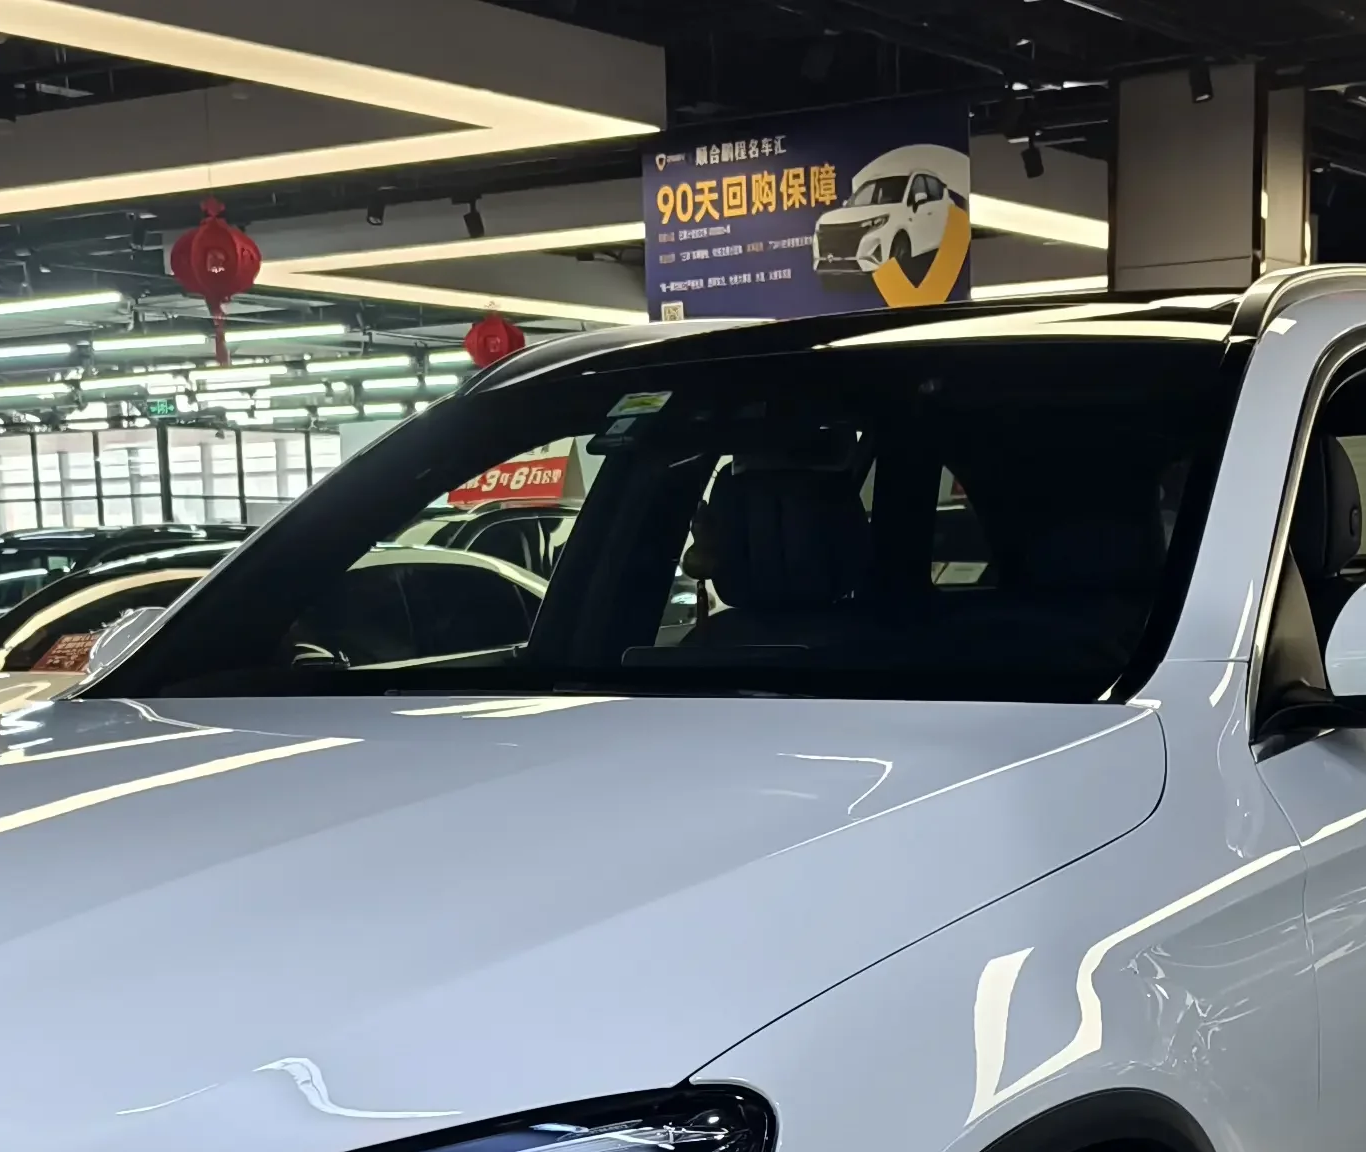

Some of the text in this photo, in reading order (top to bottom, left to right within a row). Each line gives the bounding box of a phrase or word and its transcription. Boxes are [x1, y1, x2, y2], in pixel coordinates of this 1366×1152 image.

[695, 135, 787, 166] 顺合鹏程名车汇
[656, 163, 838, 225] 90天回购保障
